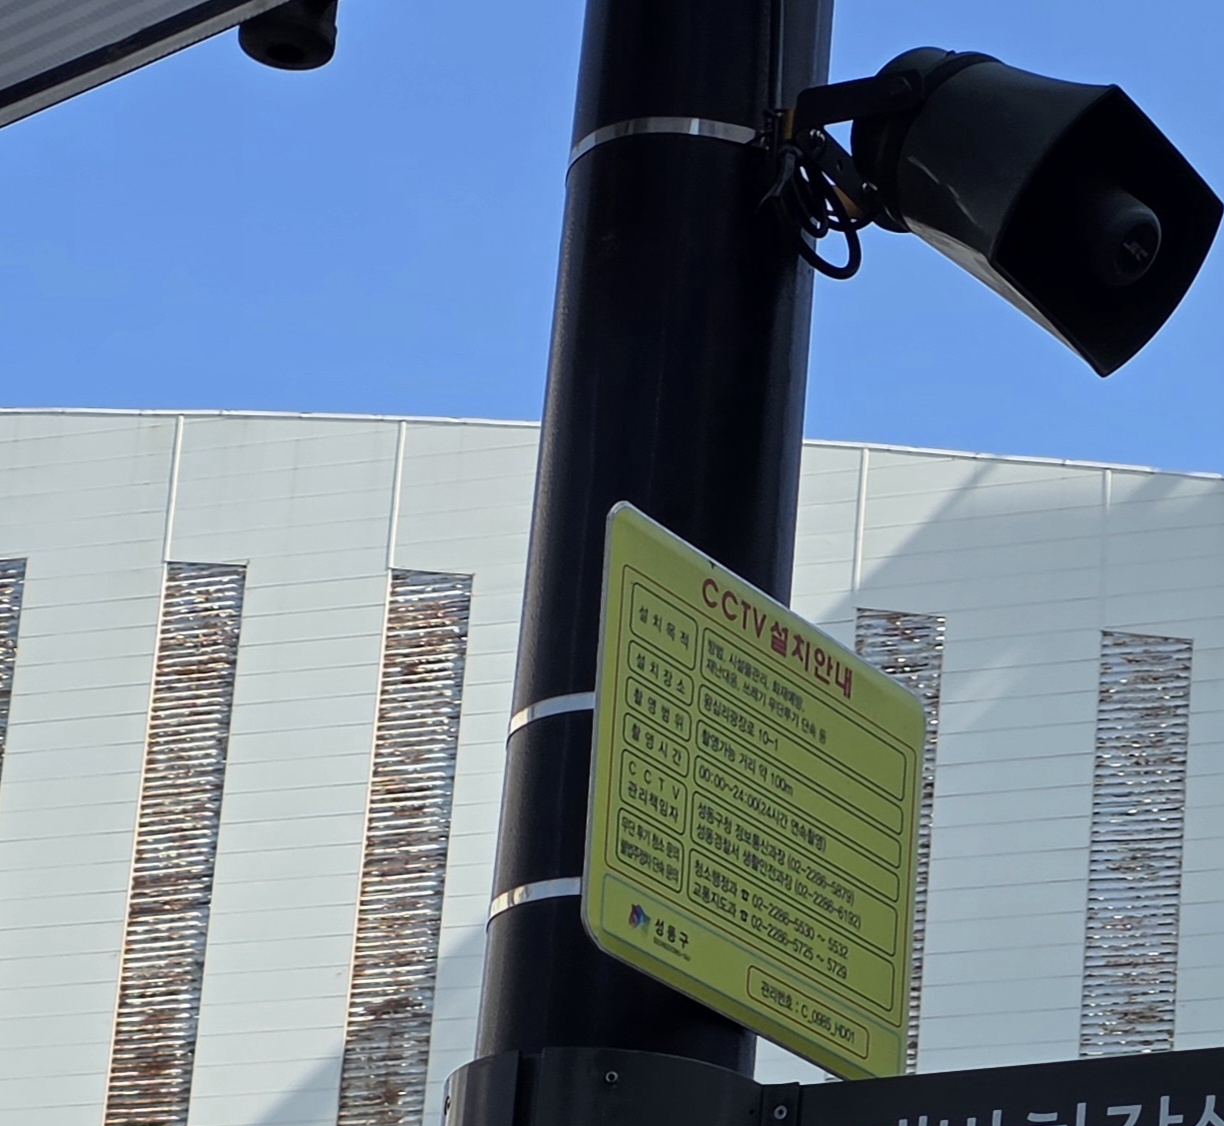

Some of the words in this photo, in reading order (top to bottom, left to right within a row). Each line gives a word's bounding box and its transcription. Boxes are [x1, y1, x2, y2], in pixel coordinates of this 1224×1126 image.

[702, 578, 852, 699] CCTV설치안내
[703, 692, 755, 737] 왕십리광장로
[759, 728, 778, 752] 10-1
[702, 728, 736, 763] 촬영가능
[739, 753, 756, 775] 거리
[759, 764, 768, 782] 약
[771, 772, 793, 797] 100m
[628, 780, 678, 824] 관리책임자
[697, 801, 732, 835] 성동구청
[696, 823, 740, 861] 성동경찰서
[695, 859, 737, 898] 청소행정과
[693, 881, 737, 919] 교통지도과
[655, 918, 689, 949] 성동구
